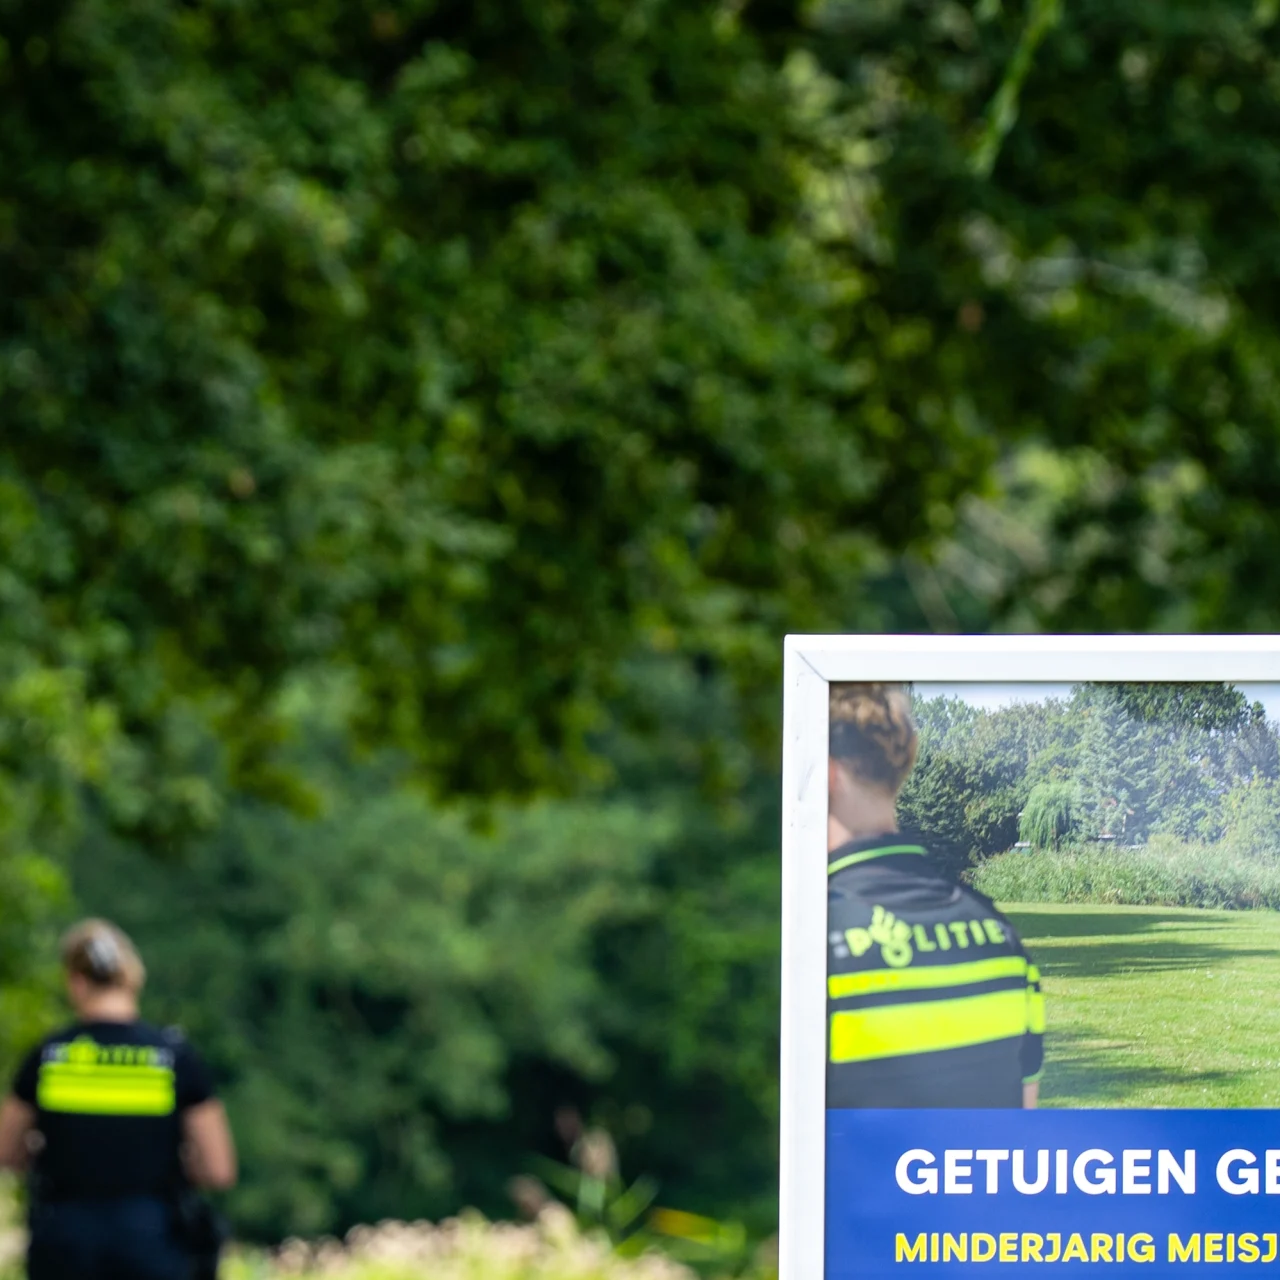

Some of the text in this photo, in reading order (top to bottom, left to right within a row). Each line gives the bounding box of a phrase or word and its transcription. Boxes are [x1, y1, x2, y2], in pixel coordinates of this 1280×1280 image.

[844, 912, 1006, 968] POLITIE
[894, 1148, 1197, 1196] GETUIGEN
[894, 1232, 1156, 1264] MINDERJARIG
